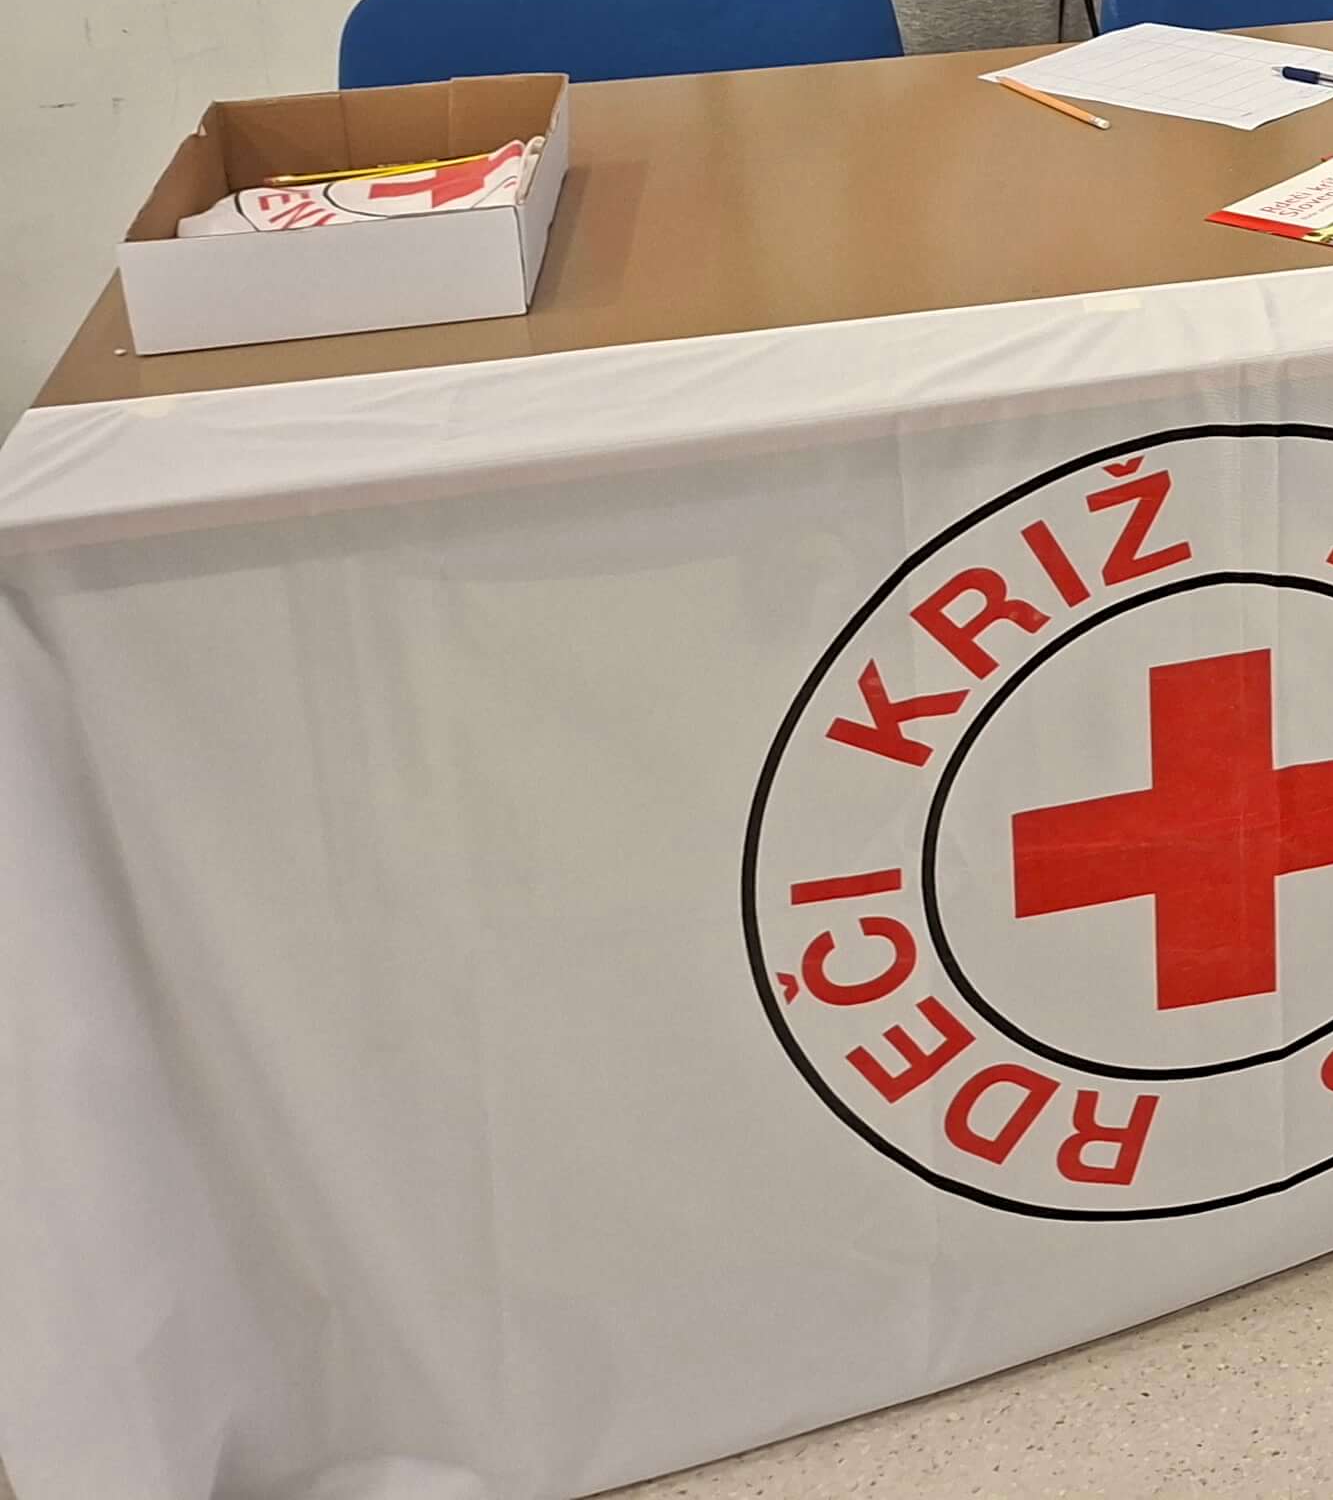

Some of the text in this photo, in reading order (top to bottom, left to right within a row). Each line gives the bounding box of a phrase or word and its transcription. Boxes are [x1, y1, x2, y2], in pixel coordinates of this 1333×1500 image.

[1260, 189, 1306, 214] Rdeči
[775, 455, 1193, 1186] RDEČI KRIŽ
